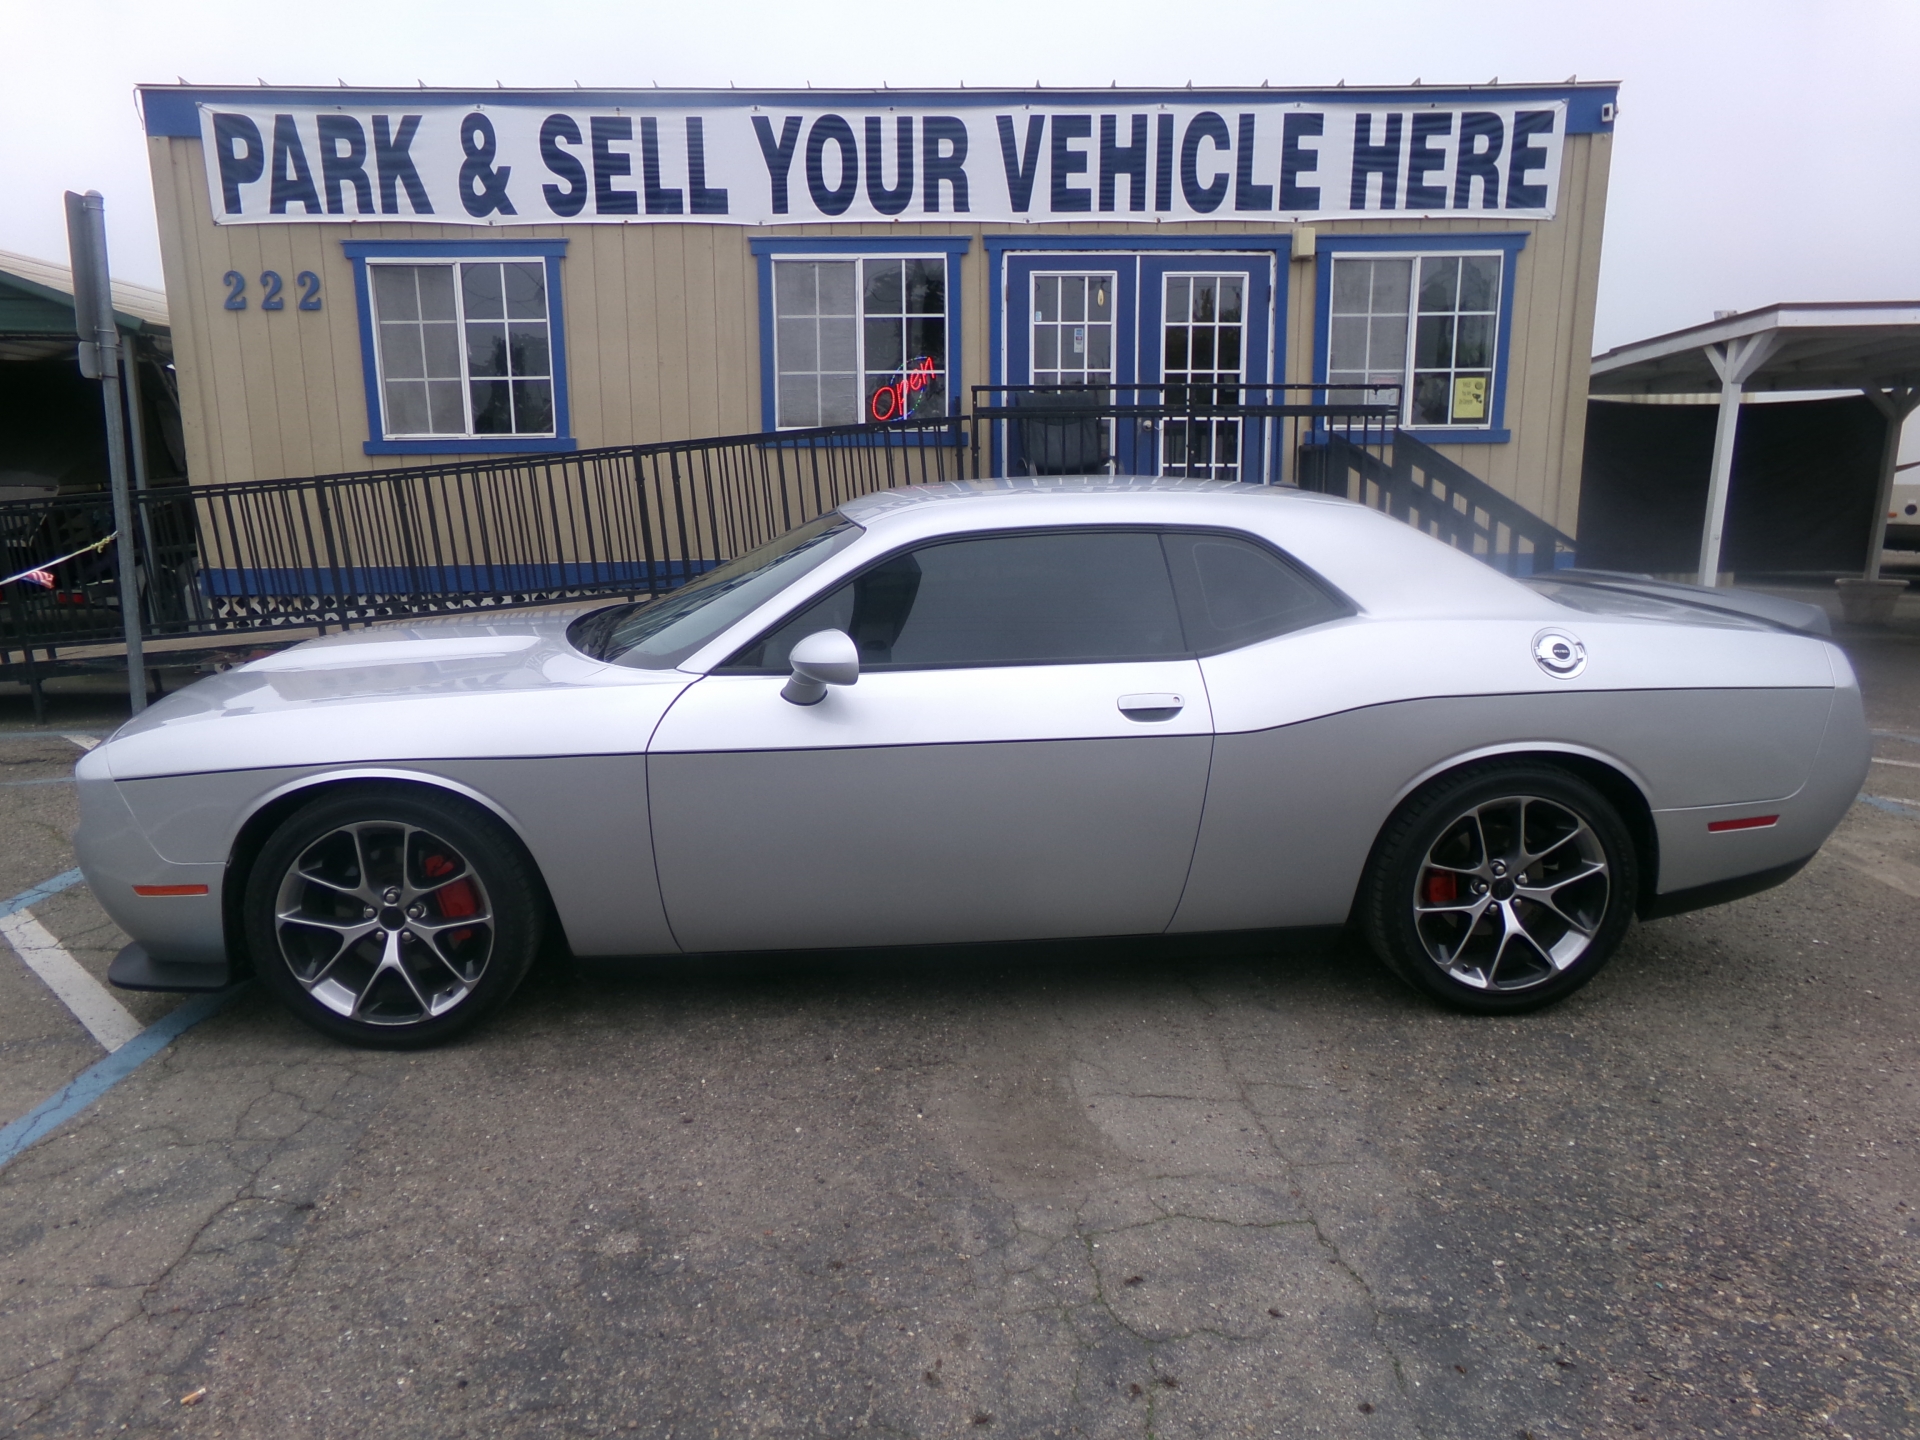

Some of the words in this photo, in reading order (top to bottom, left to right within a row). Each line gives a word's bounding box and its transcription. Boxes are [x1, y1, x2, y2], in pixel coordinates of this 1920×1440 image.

[213, 113, 435, 214] PARK
[459, 113, 517, 217] &
[540, 114, 729, 217] SELL
[751, 114, 970, 215] YOUR
[996, 112, 1325, 213] VEHICLE
[1350, 111, 1555, 209] HERE
[223, 269, 323, 311] 222
[872, 356, 936, 421] Open
